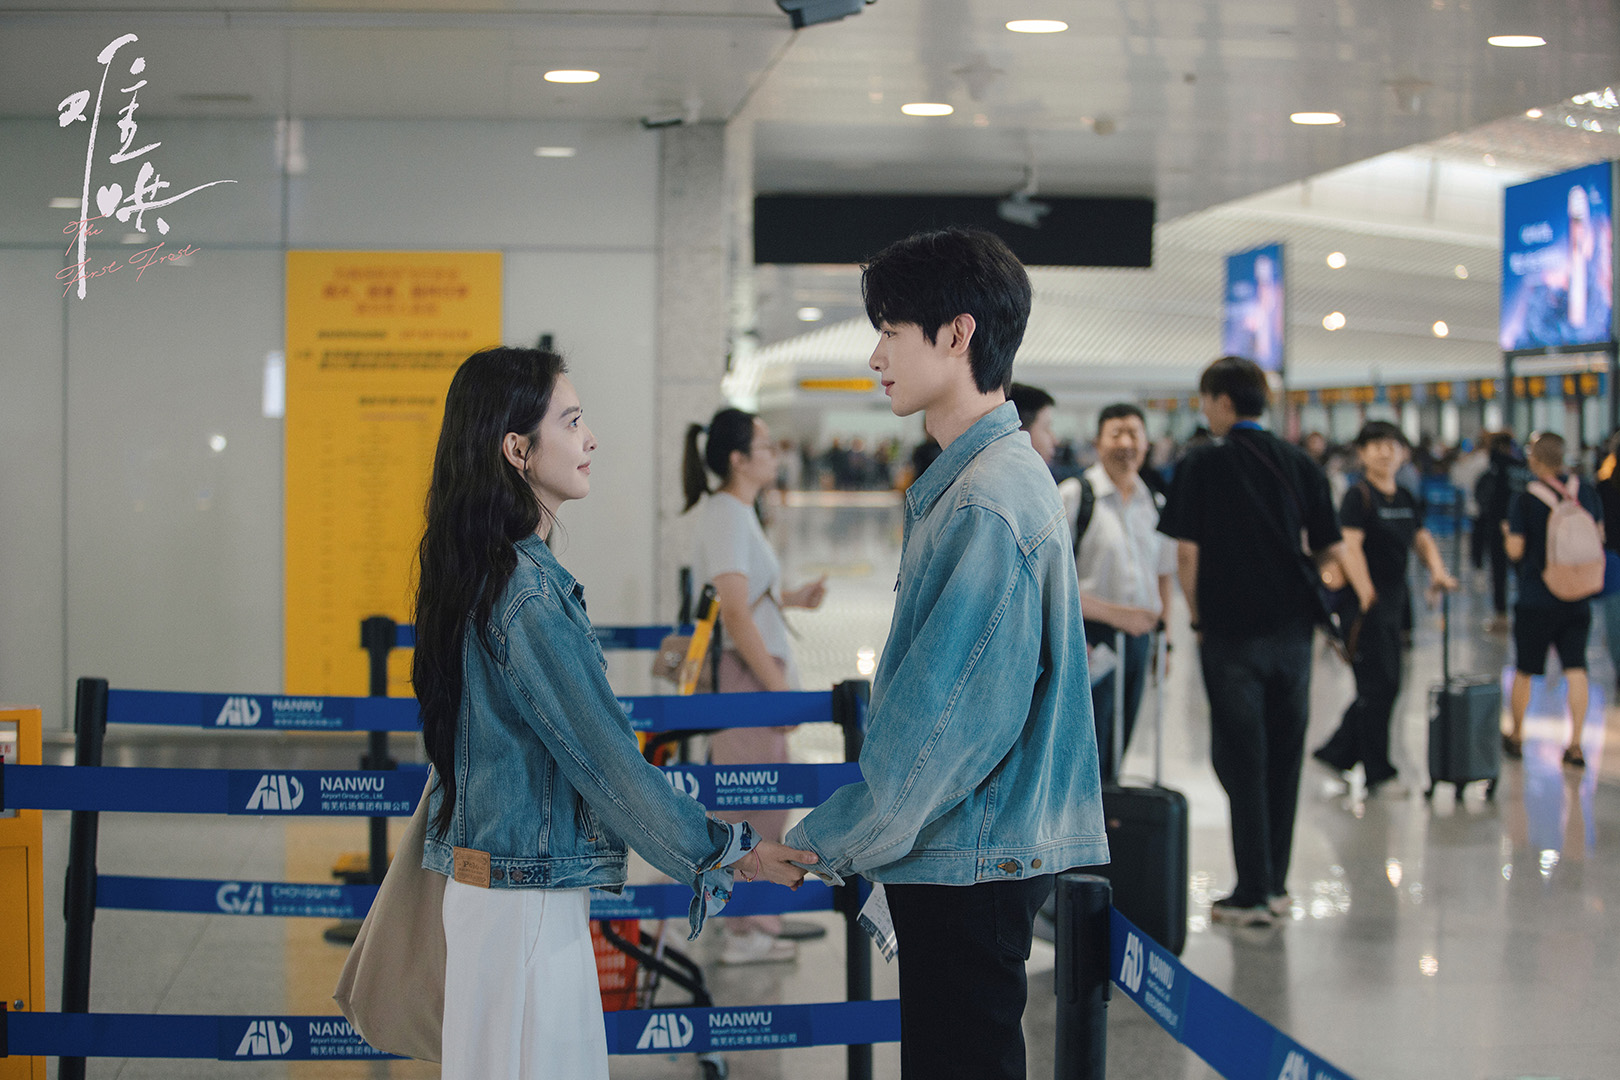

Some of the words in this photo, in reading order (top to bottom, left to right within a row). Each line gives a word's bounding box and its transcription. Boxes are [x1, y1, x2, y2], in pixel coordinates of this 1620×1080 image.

[272, 698, 324, 713] NANWU
[320, 776, 385, 791] NANWU
[715, 771, 779, 786] NANWU
[708, 1011, 772, 1027] NANWU
[309, 1022, 358, 1036] NANW
